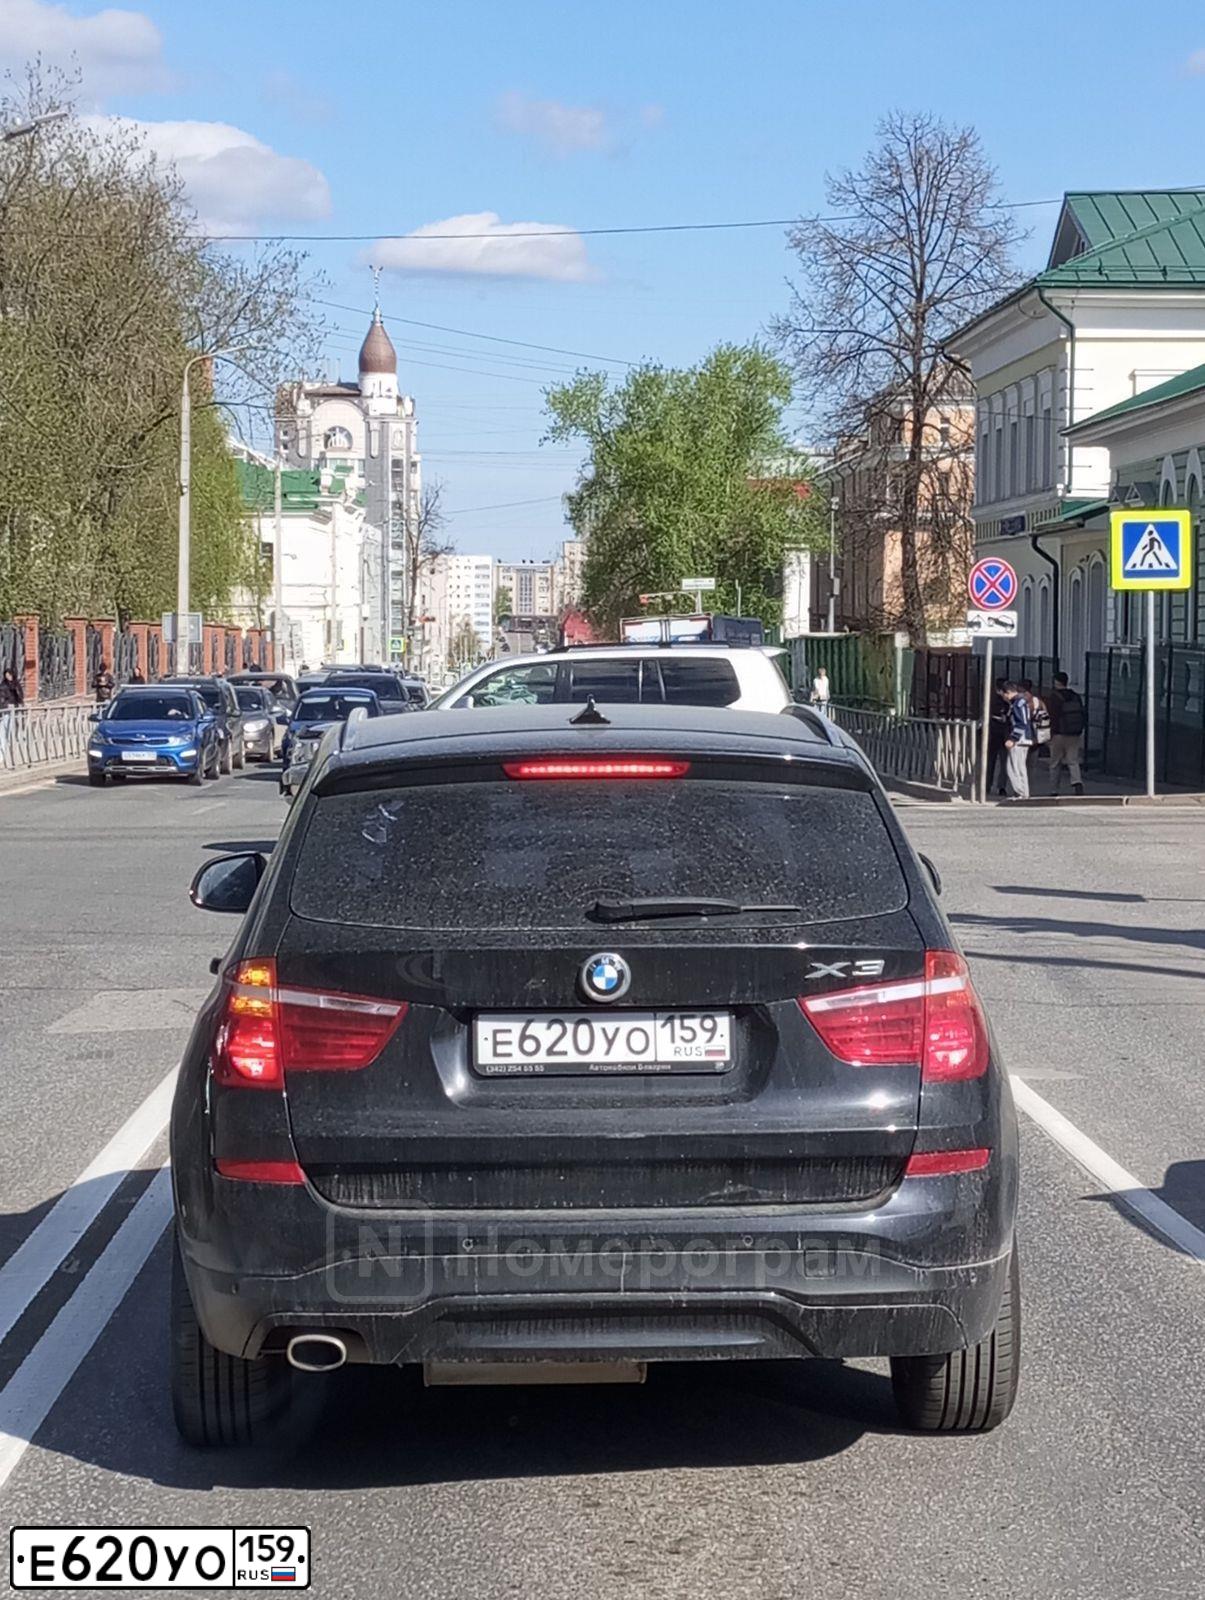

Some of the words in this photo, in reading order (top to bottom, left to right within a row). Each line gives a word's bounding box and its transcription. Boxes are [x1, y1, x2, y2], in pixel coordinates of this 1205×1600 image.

[804, 960, 885, 978] X3
[660, 1014, 718, 1044] 159
[674, 1046, 703, 1057] RUS
